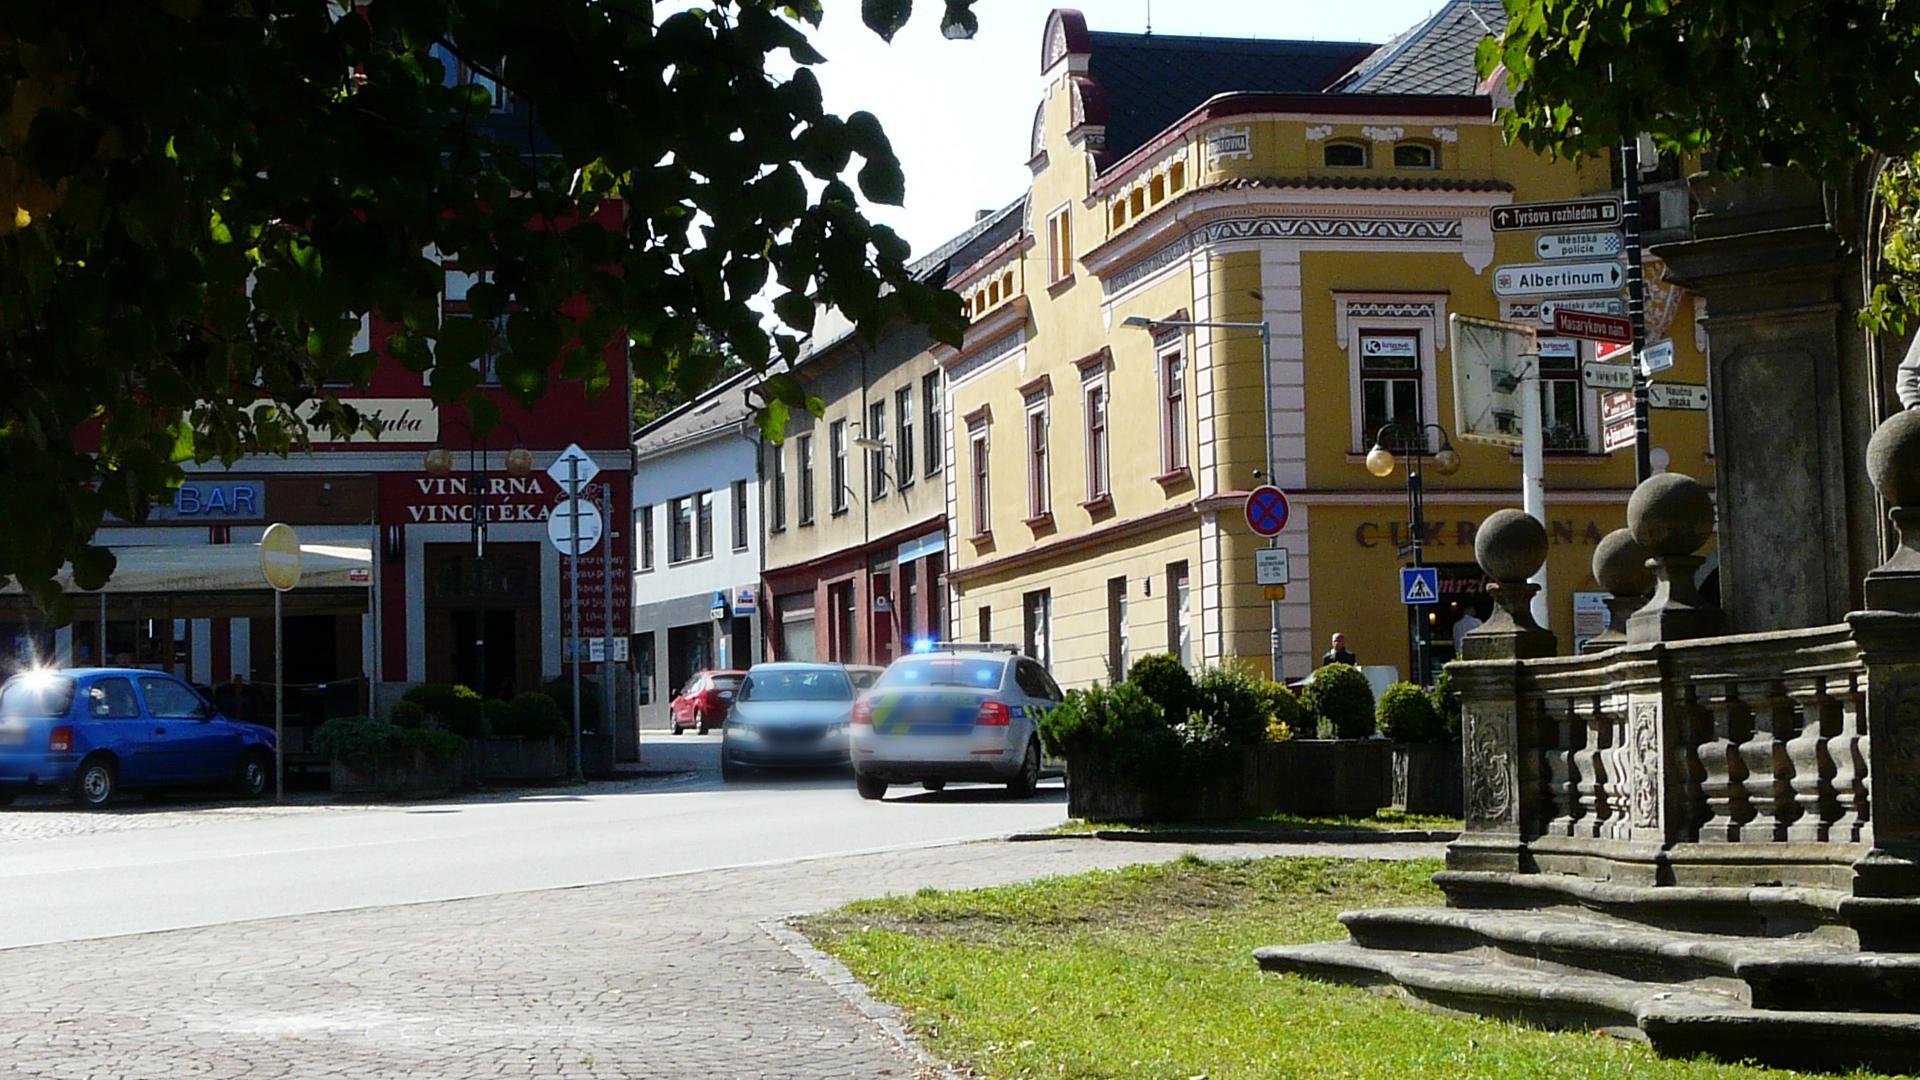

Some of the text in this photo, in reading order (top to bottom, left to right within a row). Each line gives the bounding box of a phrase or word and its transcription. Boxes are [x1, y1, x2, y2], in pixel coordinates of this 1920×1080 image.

[1514, 205, 1598, 226] Tyršova rozhledna
[1562, 245, 1594, 256] policie
[1520, 271, 1604, 288] Albertinum
[1561, 313, 1607, 337] Masarykovo
[416, 478, 543, 495] VINRNA
[177, 485, 256, 514] BAR
[1356, 520, 1600, 548] CUKRNA
